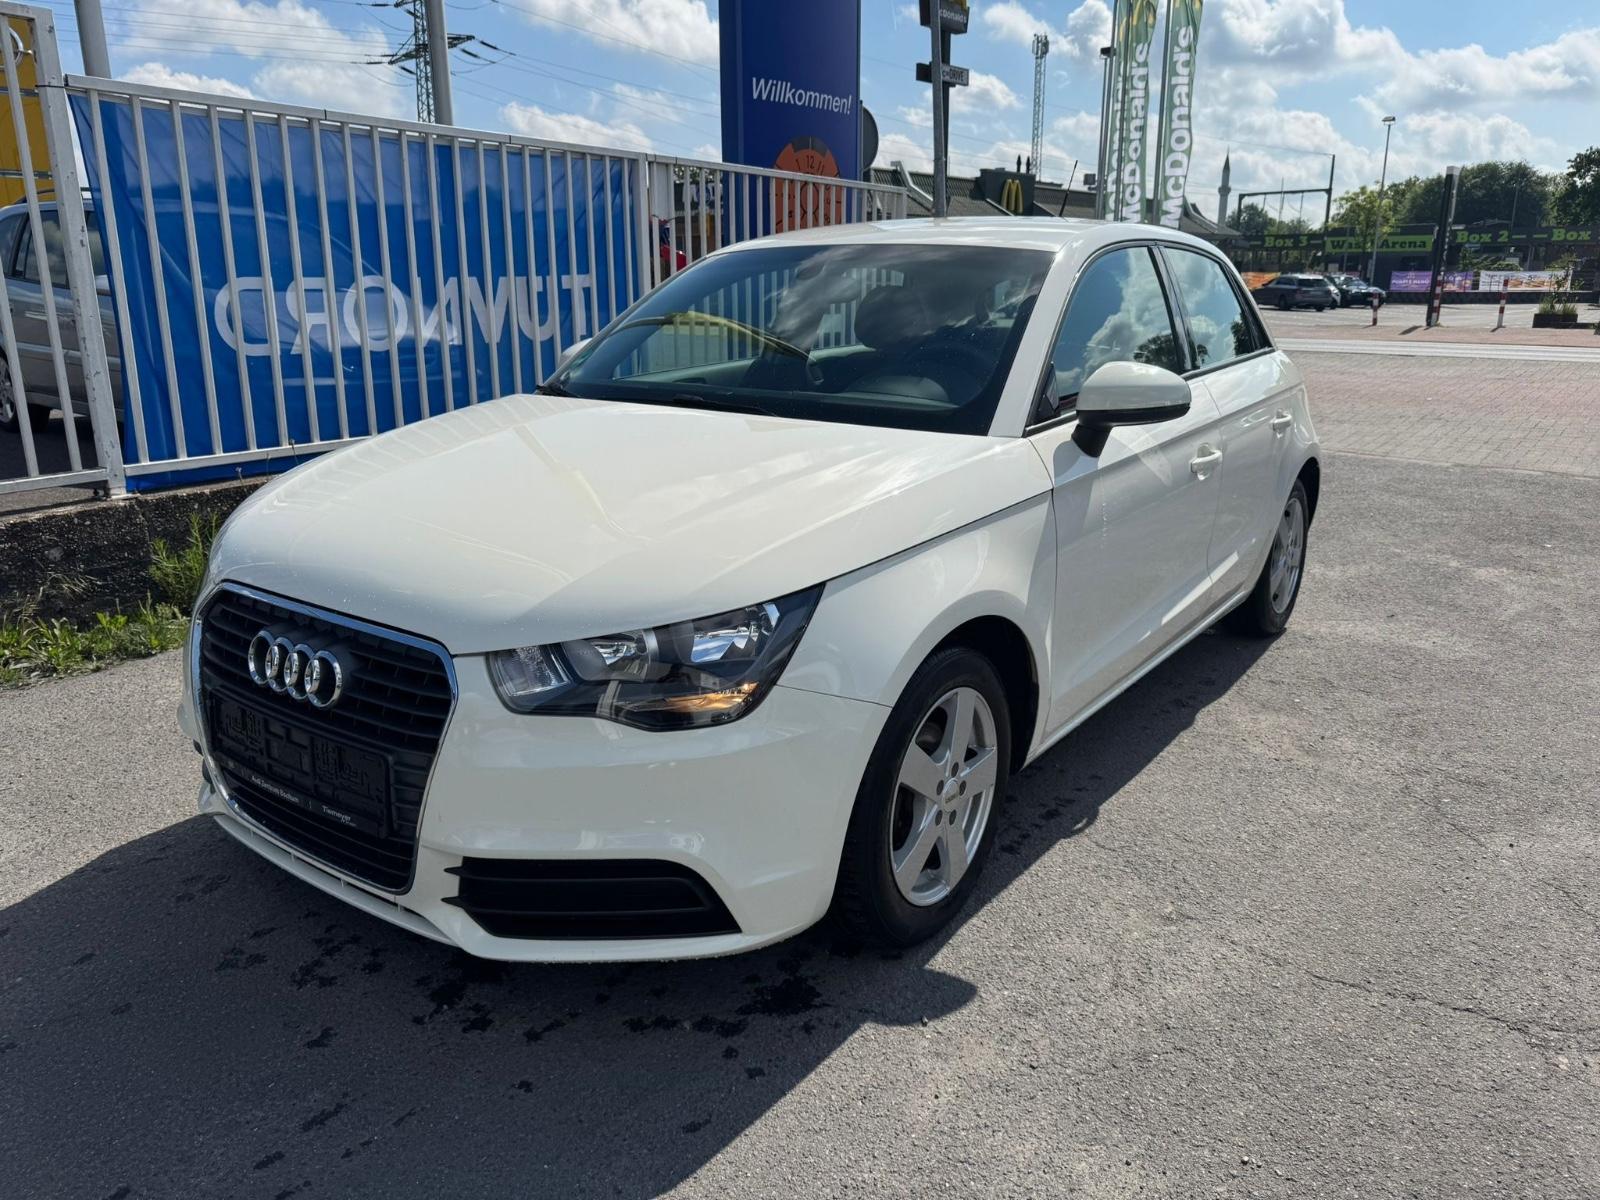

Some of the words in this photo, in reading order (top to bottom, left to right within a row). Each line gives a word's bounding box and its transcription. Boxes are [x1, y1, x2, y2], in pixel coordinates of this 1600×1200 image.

[752, 76, 852, 115] Willkommen!
[1122, 42, 1149, 223] McDonald's
[1160, 25, 1194, 229] McDonald's
[806, 155, 815, 170] 12
[1455, 230, 1492, 243] Box
[1498, 230, 1509, 242] 2
[1552, 228, 1592, 241] Box
[1264, 236, 1294, 248] Box
[1379, 239, 1427, 250] Arena
